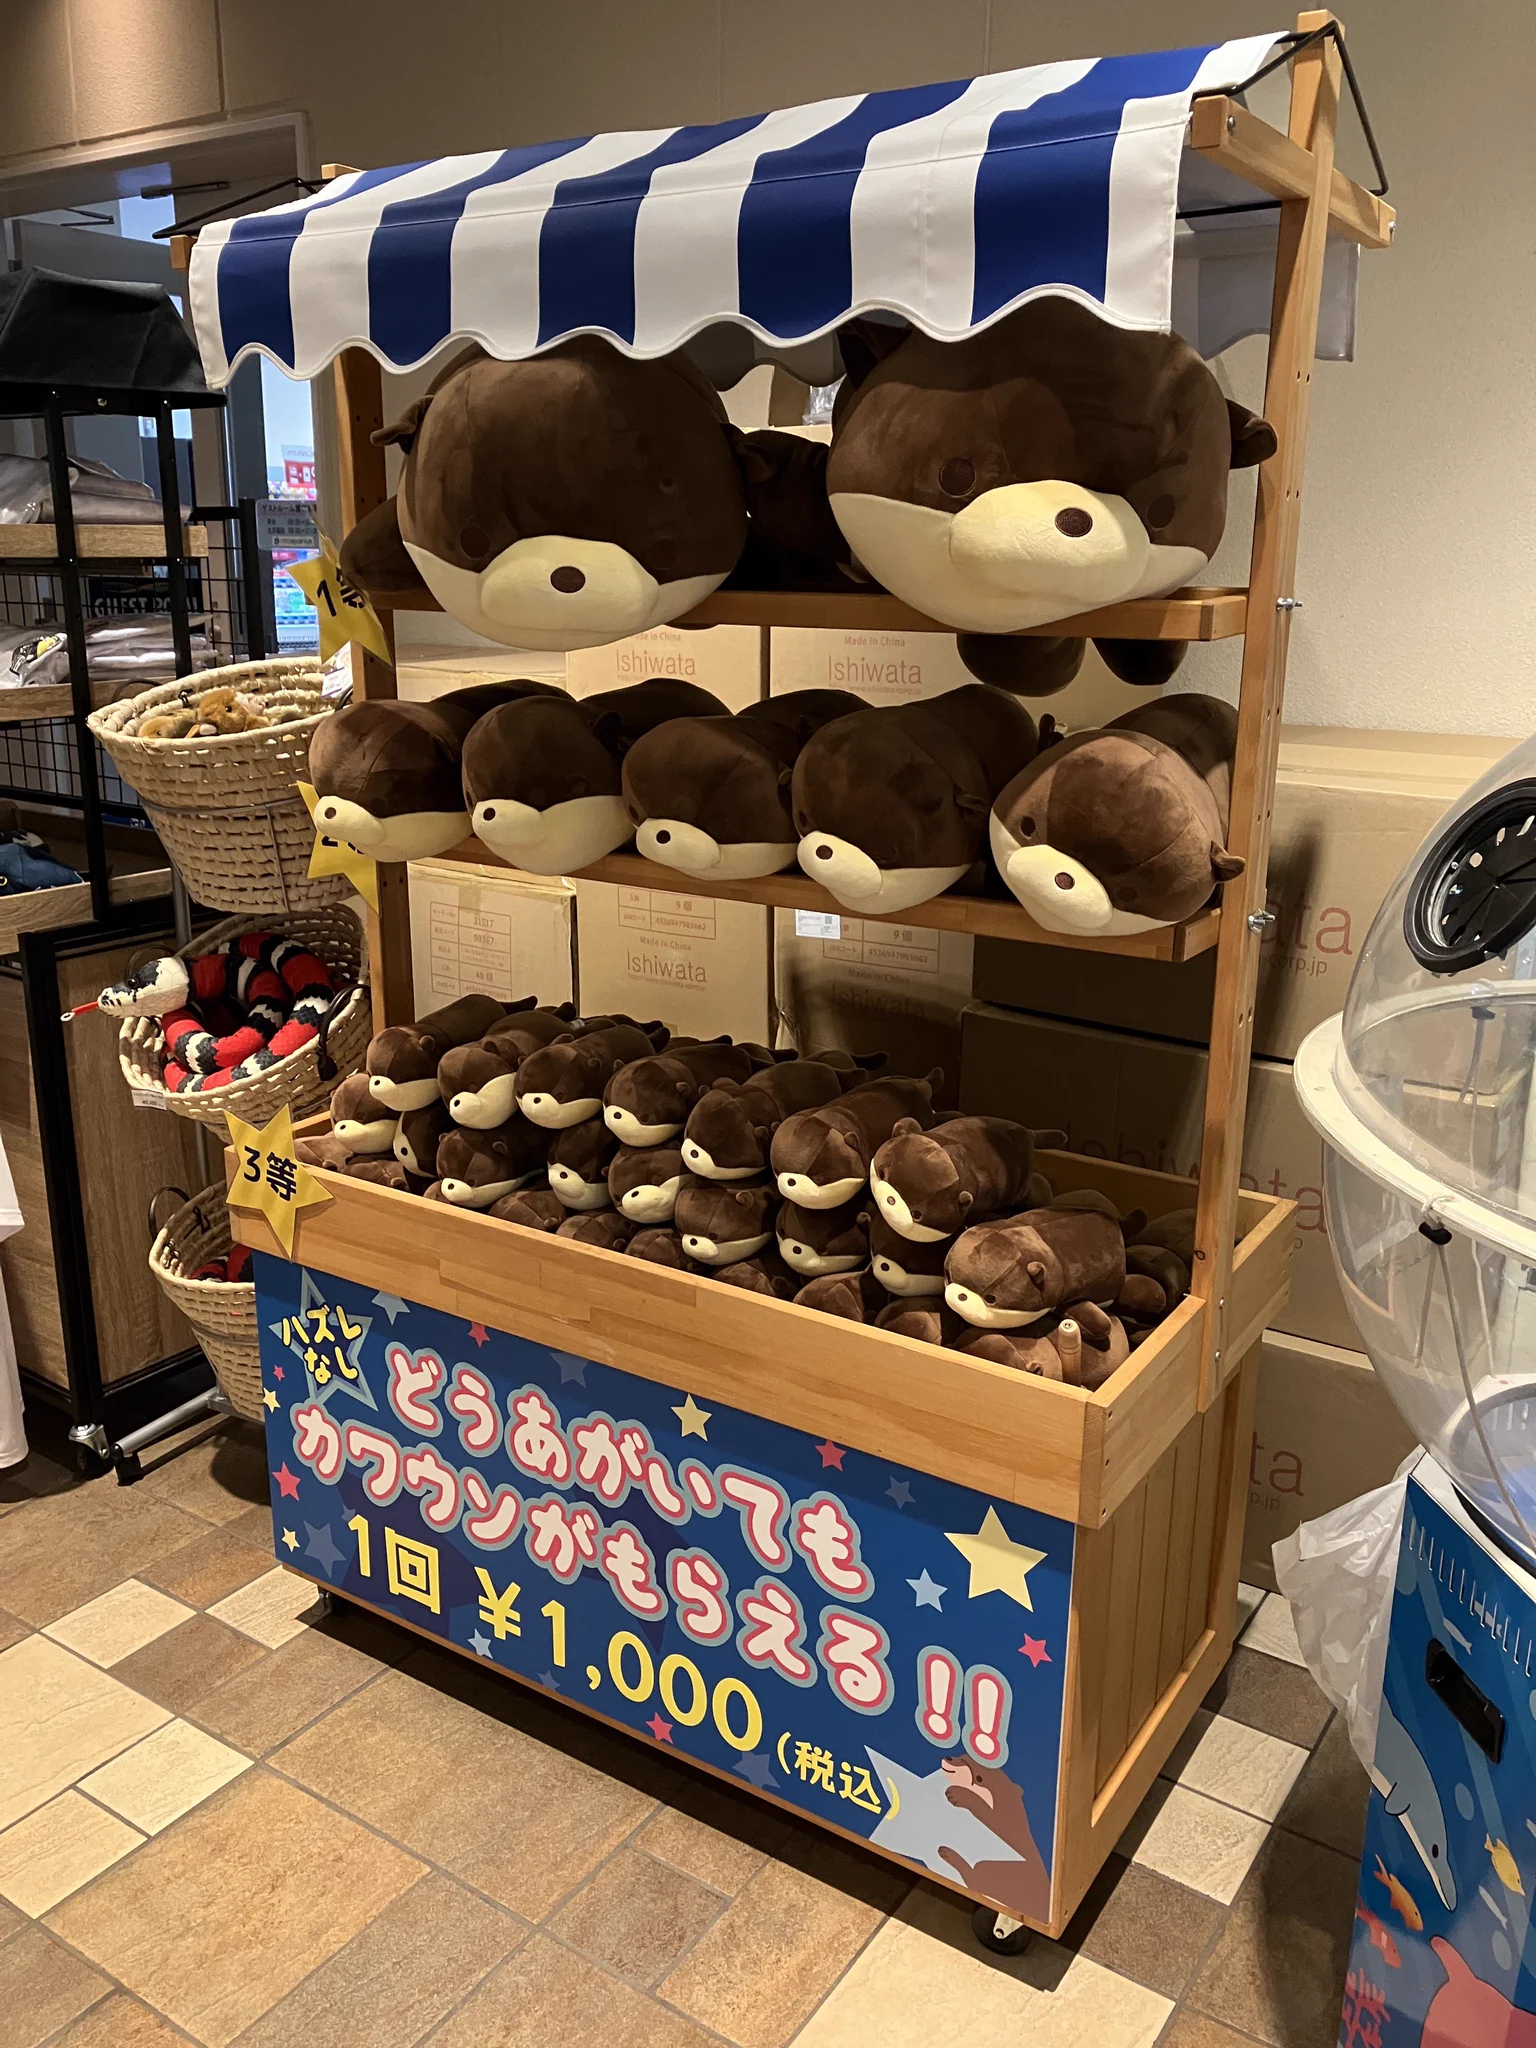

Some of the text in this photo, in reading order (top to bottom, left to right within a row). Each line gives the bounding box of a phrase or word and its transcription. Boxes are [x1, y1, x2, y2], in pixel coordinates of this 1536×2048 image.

[94, 597, 148, 617] GUEST
[659, 631, 682, 642] China
[843, 635, 867, 646] Made
[880, 636, 905, 647] China
[616, 648, 697, 676] Ishiwata
[828, 655, 922, 685] Ishiwata
[473, 916, 495, 928] 31517
[640, 936, 659, 947] Made
[669, 940, 692, 952] China
[627, 950, 708, 984] Ishiwata
[848, 968, 871, 979] Made
[884, 973, 910, 986] China
[832, 983, 926, 1018] Ishiwata
[243, 1145, 298, 1202] 3等
[281, 1304, 363, 1347] ハズレ
[303, 1345, 359, 1385] なし
[388, 1347, 872, 1597] どうあがいても
[347, 1513, 901, 1821] 1回 ¥1,000 (税込)
